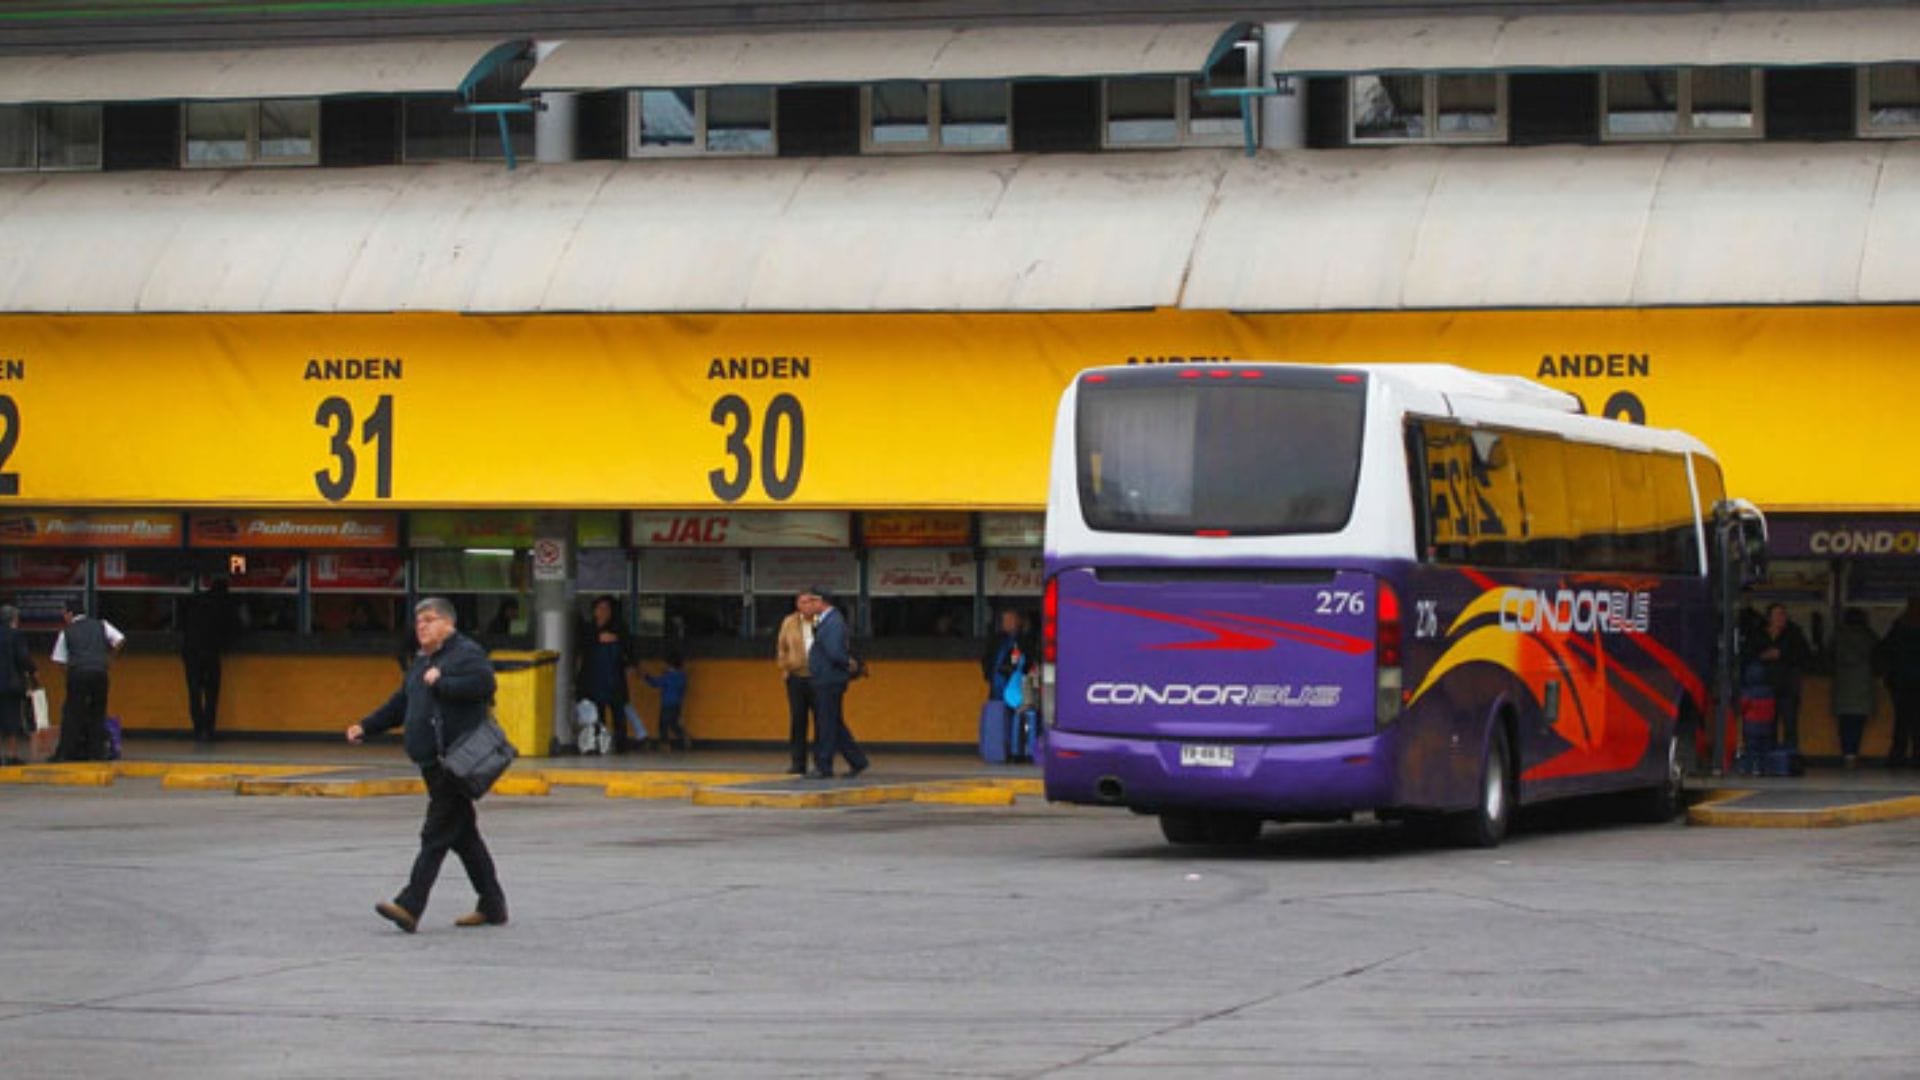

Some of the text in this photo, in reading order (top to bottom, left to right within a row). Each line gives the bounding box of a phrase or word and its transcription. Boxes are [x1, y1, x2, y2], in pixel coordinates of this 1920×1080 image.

[0, 359, 24, 380] N
[304, 358, 403, 380] ANDEN
[708, 357, 811, 379] ANDEN
[1537, 354, 1650, 377] ANDEN
[315, 394, 394, 502] 31
[708, 392, 806, 502] 30
[651, 516, 730, 543] JAC
[1315, 590, 1365, 615] 276
